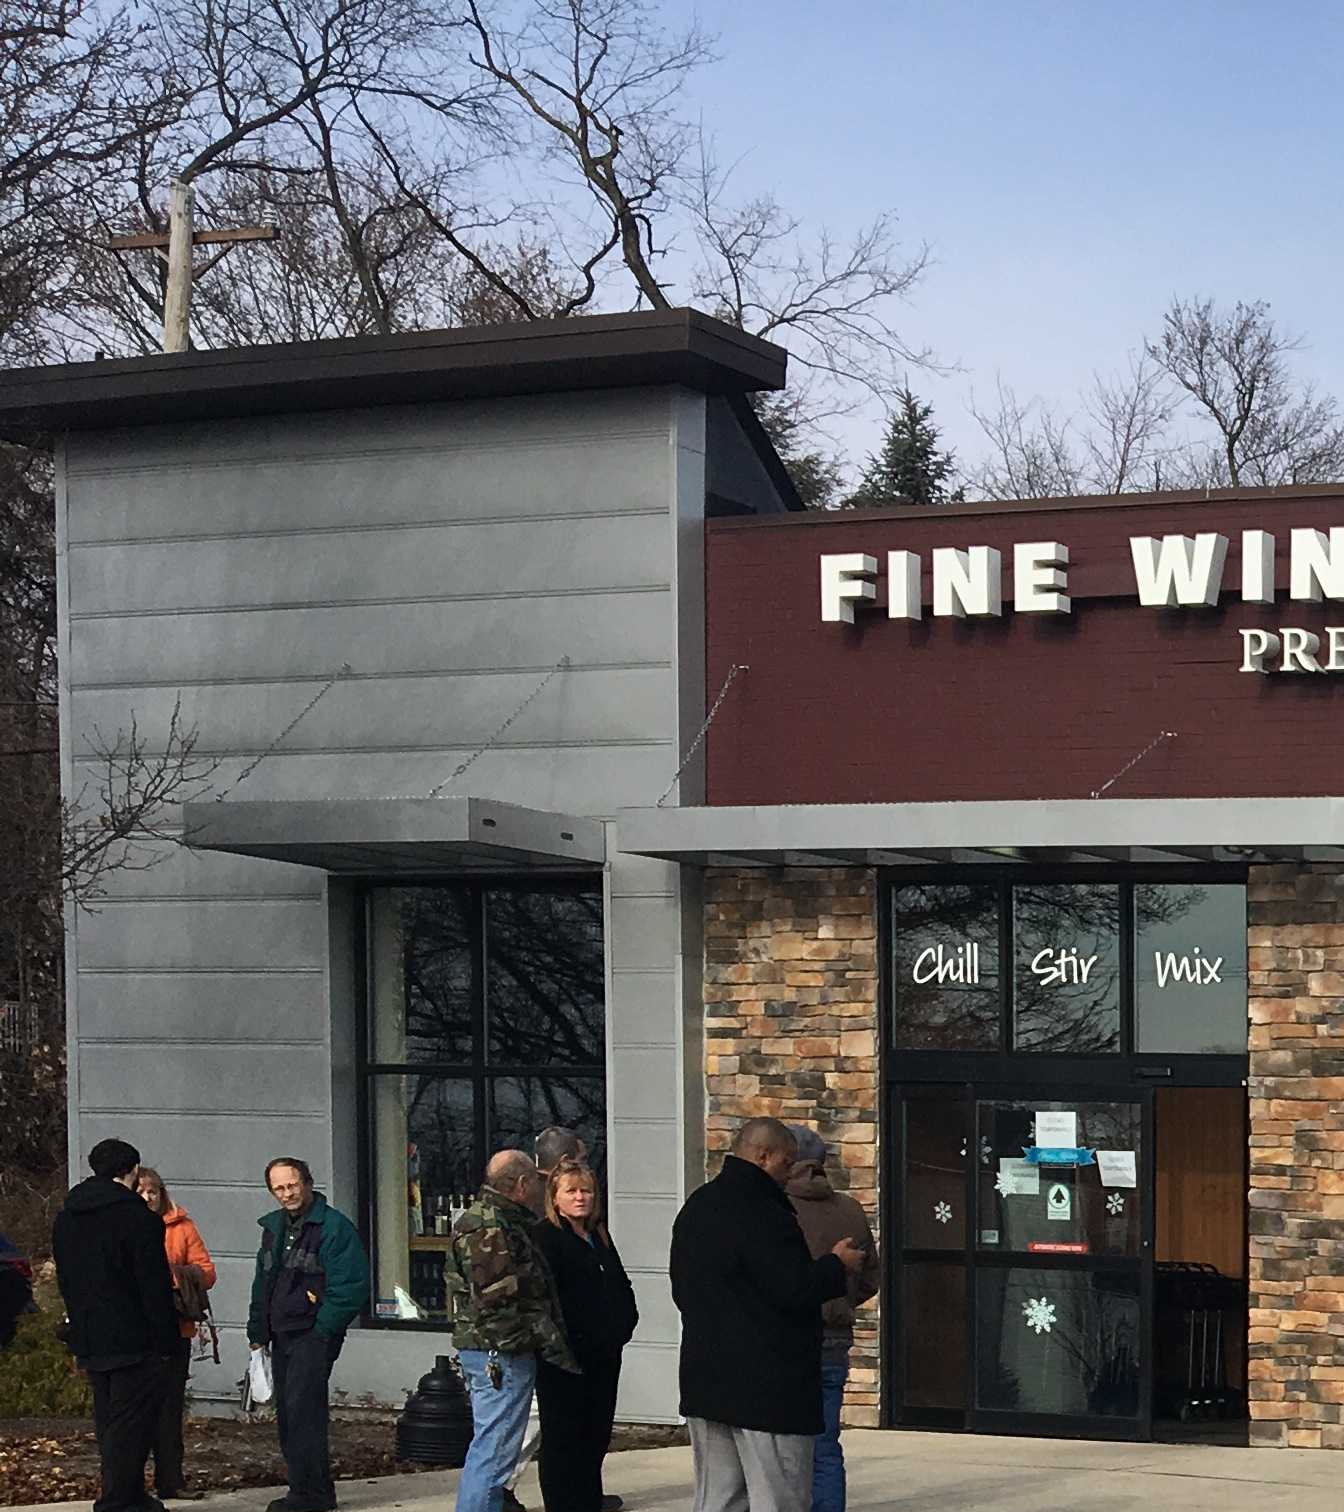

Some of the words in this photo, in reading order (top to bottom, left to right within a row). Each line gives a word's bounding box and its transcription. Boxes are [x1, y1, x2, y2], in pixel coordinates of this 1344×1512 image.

[820, 541, 1071, 624] FINE
[912, 942, 980, 985] Chill
[1030, 947, 1099, 987] Stir
[1155, 946, 1223, 989] Mix
